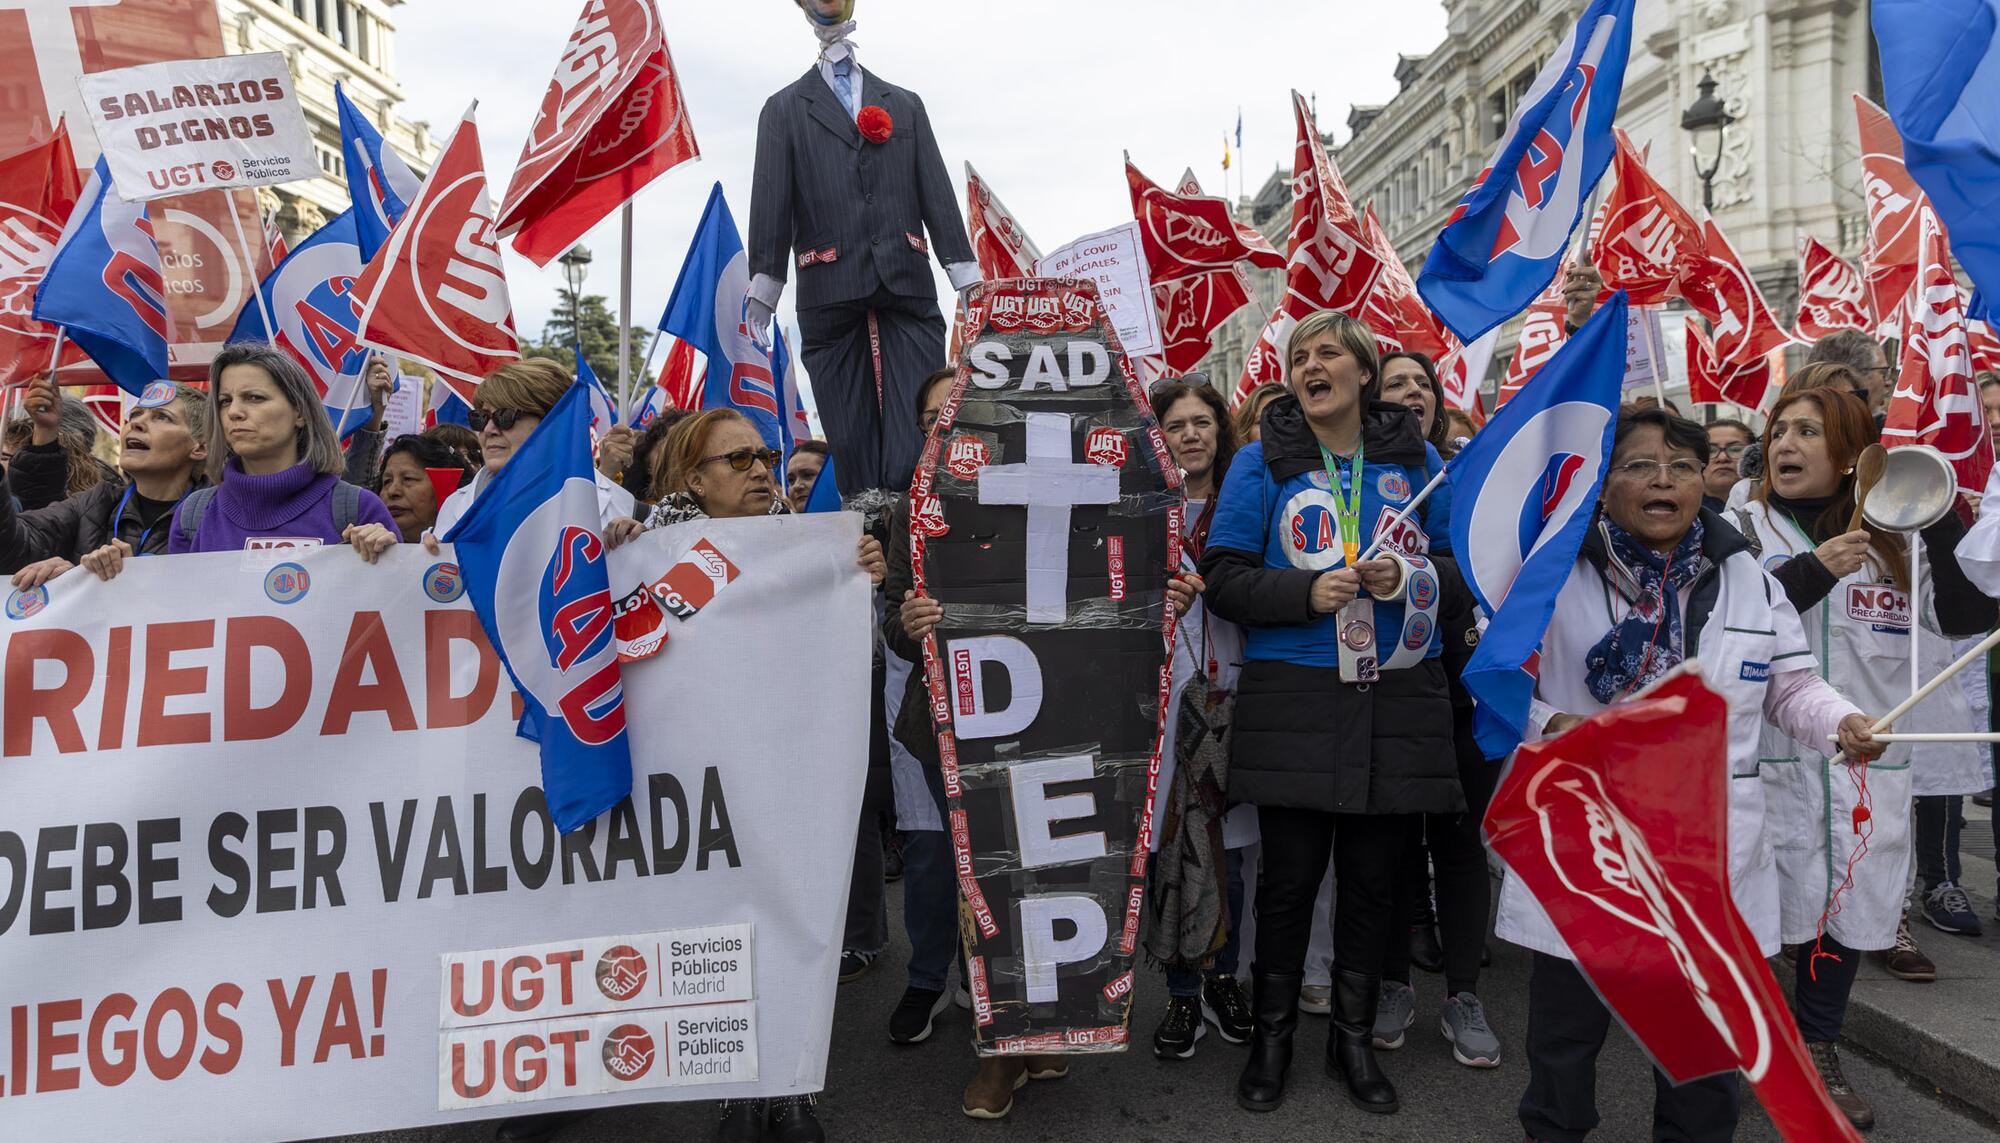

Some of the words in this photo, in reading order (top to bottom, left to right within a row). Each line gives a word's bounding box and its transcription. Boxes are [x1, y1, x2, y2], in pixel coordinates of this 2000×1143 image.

[99, 77, 284, 121] SALARIOS
[135, 113, 275, 150] DIGNOS
[147, 163, 206, 190] UGT
[242, 155, 291, 168] Servicios
[245, 166, 291, 180] Públicos
[160, 249, 204, 269] cios
[1056, 259, 1069, 271] EN
[1083, 243, 1118, 257] COVID
[163, 274, 204, 294] icos
[1016, 280, 1044, 290] UGT
[1103, 287, 1121, 297] SIN
[969, 307, 982, 323] GT
[992, 296, 1025, 314] UGT
[1027, 297, 1060, 316] UGT
[1062, 291, 1094, 318] UGT
[970, 341, 1111, 392] SAD
[940, 401, 957, 426] UGT
[951, 443, 984, 461] UGT
[1091, 433, 1123, 452] UGT
[1150, 429, 1167, 455] UGT
[917, 472, 932, 496] UGT
[1169, 509, 1179, 537] UGT
[654, 582, 696, 615] CGT
[1112, 573, 1123, 599] UGT
[613, 587, 650, 619] CGT
[1851, 589, 1906, 611] NO+
[1851, 608, 1910, 623] PRECARIEDAD
[956, 650, 970, 679] UGT
[948, 768, 960, 796] UGT
[206, 805, 348, 918] SER
[369, 766, 742, 903] VALORADA
[957, 846, 971, 875] UGT
[1130, 887, 1143, 917] UGT
[976, 908, 996, 936] UGT
[450, 949, 584, 1017] UGT
[671, 936, 743, 957] Servicios
[671, 957, 738, 978] Públicos
[672, 976, 726, 996] Madrid
[1106, 970, 1133, 998] UGT
[975, 994, 990, 1023] UGT
[0, 981, 244, 1099] IEGOS
[266, 967, 389, 1068] YA!
[1068, 1031, 1096, 1044] UGT
[451, 1029, 590, 1099] UGT
[677, 1016, 749, 1037] Servicios
[678, 1037, 744, 1057] Públicos
[999, 1041, 1026, 1053] UGT
[679, 1056, 732, 1077] Madrid
